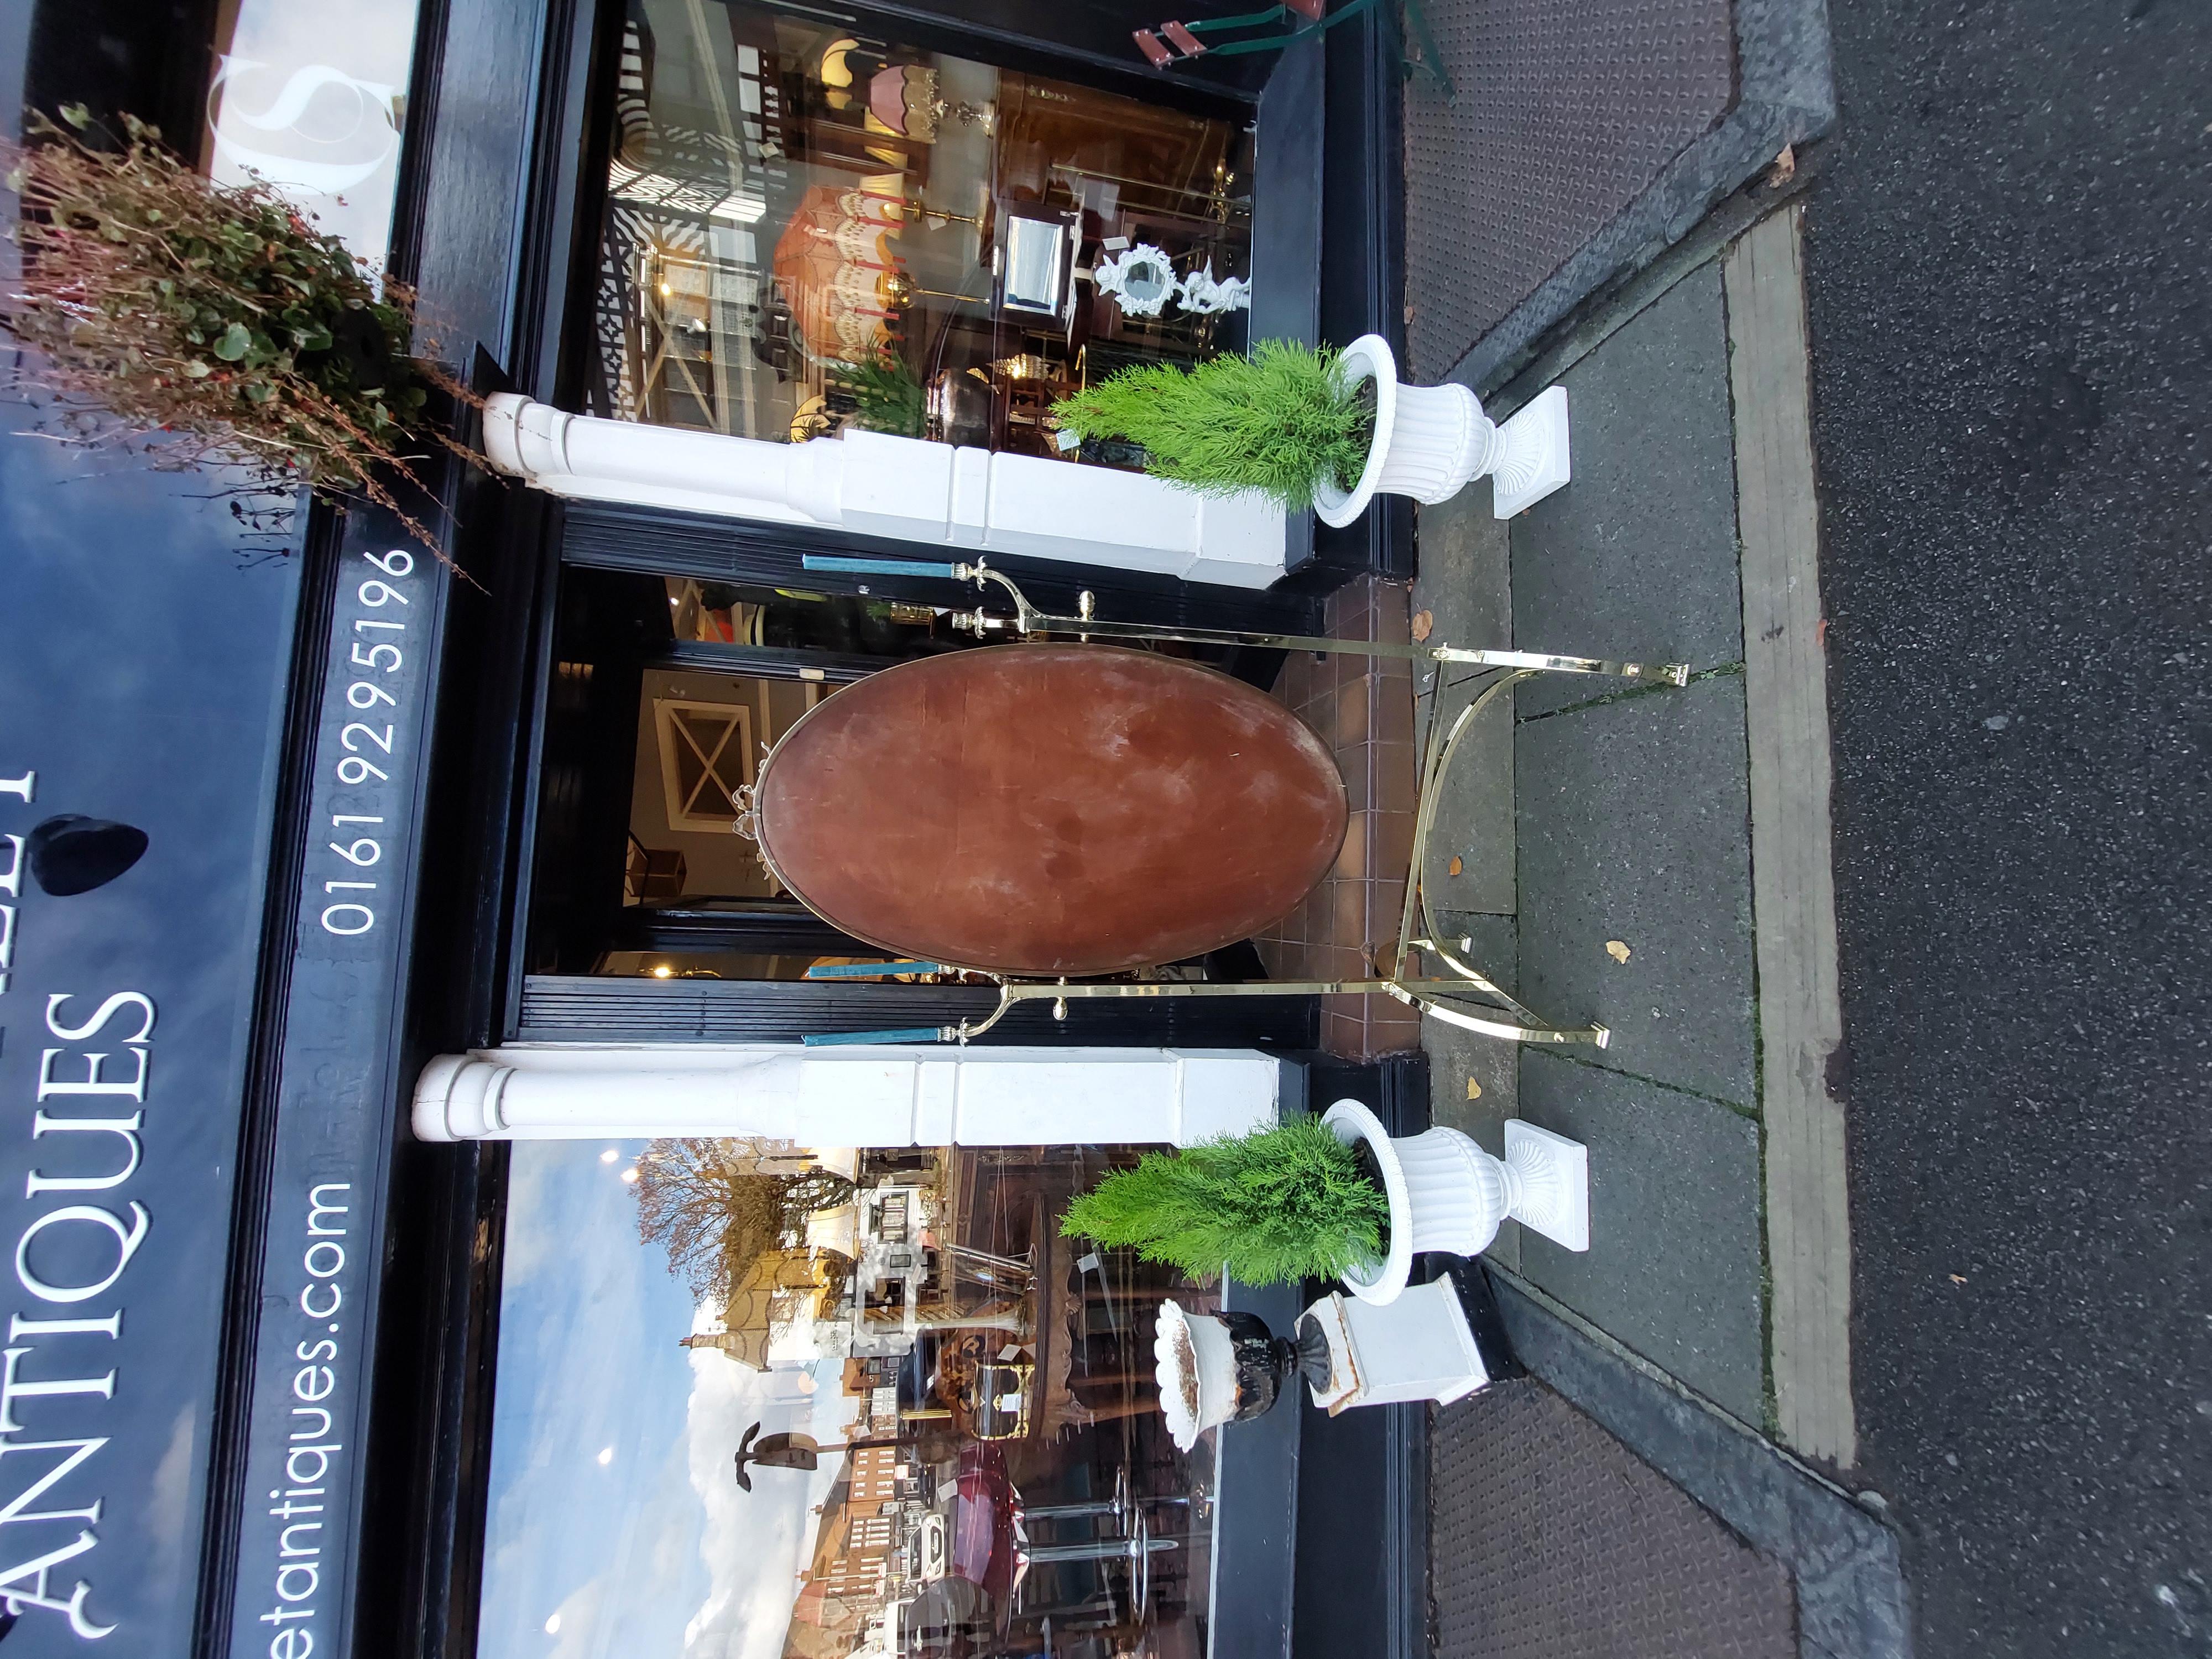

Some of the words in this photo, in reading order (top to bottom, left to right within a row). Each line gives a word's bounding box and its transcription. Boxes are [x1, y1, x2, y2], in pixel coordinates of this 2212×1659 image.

[337, 550, 414, 784] 9295196
[322, 815, 383, 935] 0161
[0, 992, 154, 1639] ANTIQUES
[260, 1183, 350, 1659] etantiques.com
